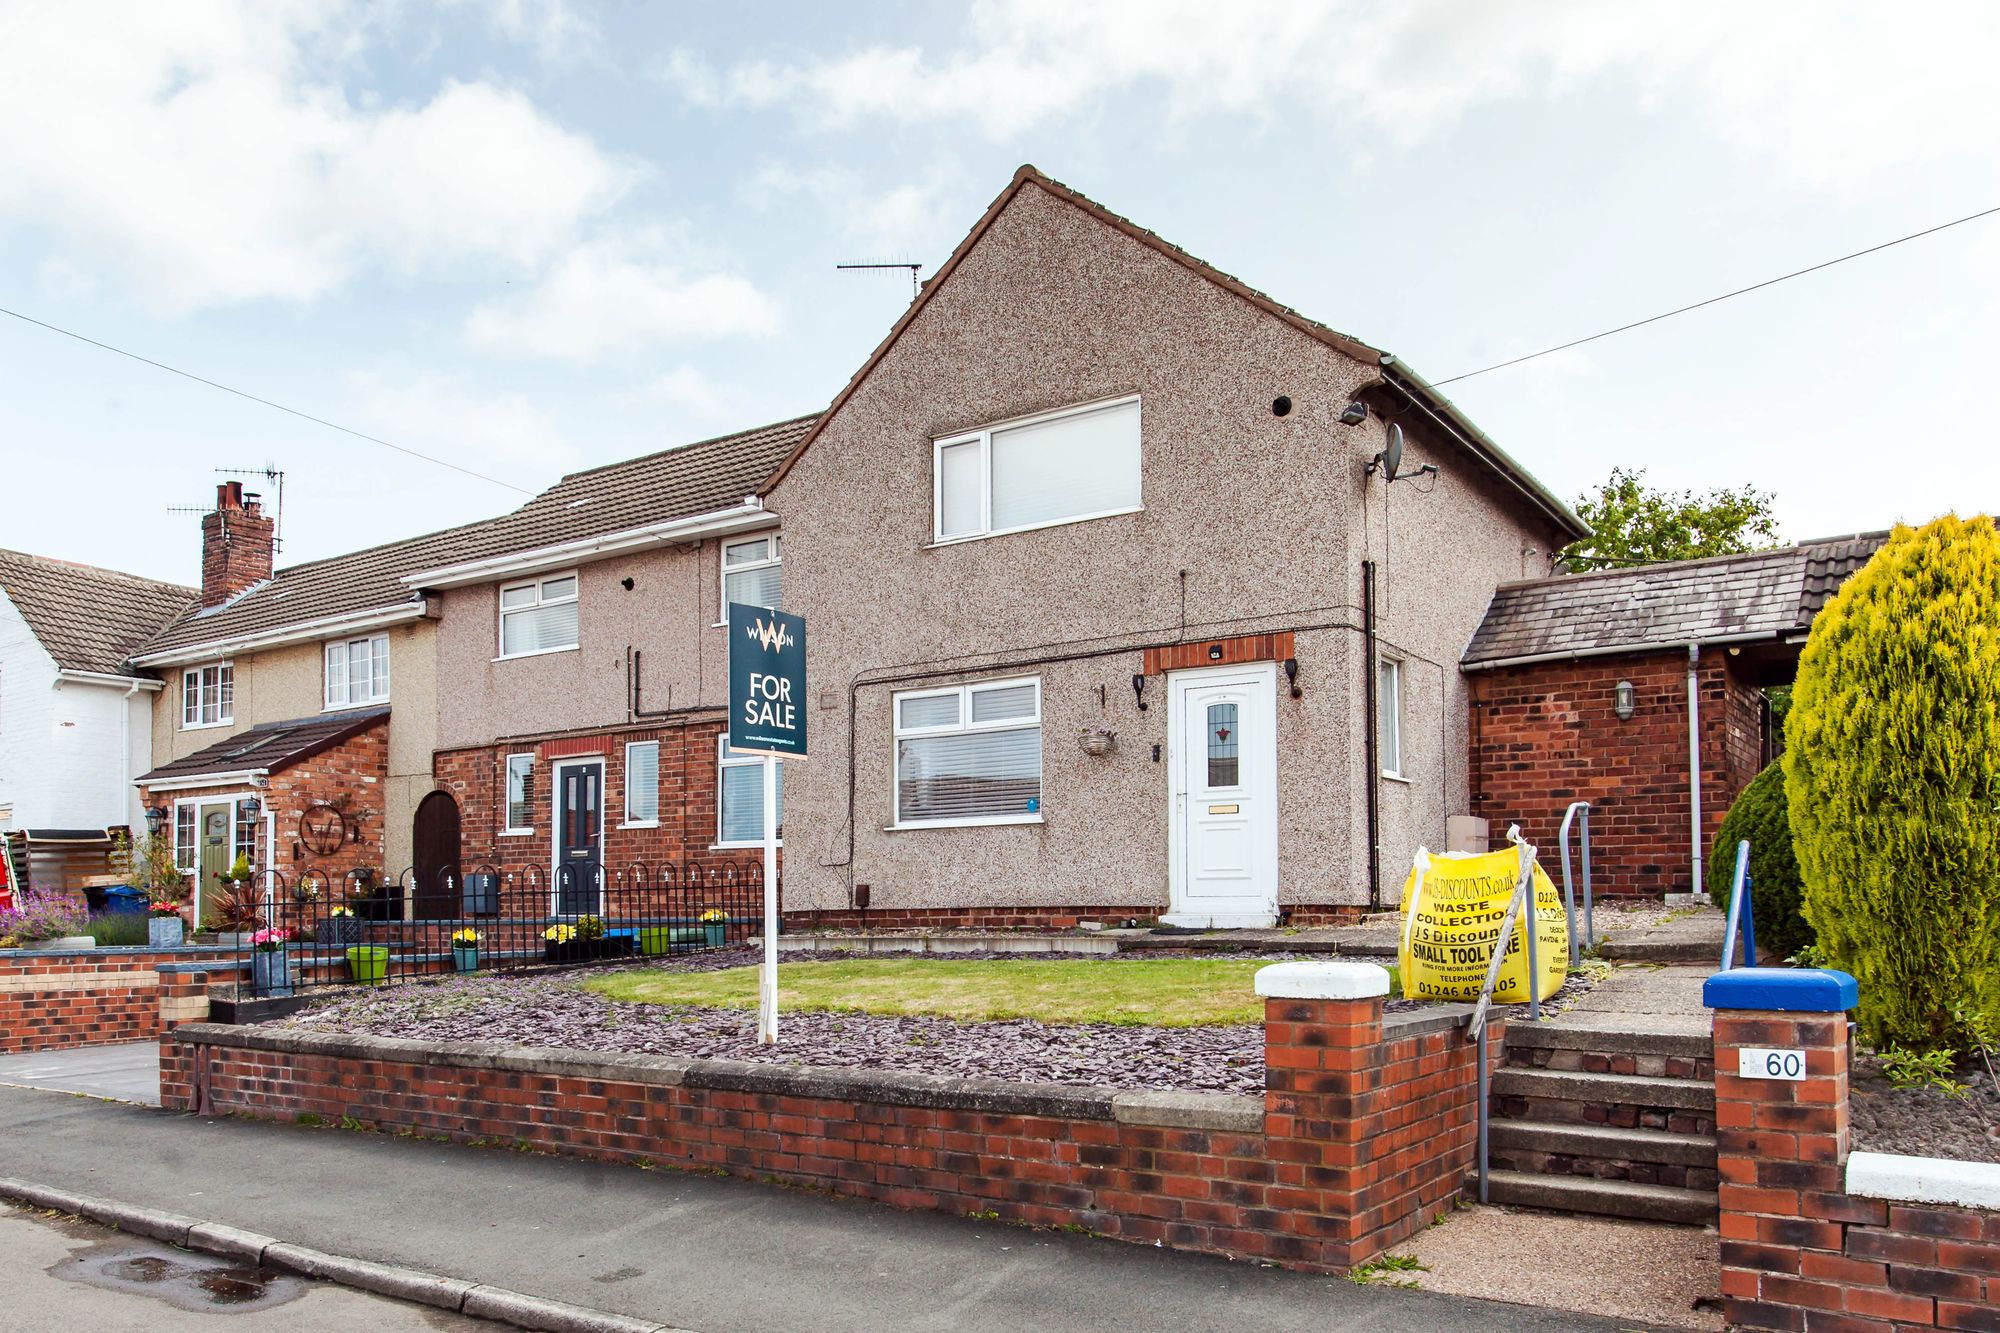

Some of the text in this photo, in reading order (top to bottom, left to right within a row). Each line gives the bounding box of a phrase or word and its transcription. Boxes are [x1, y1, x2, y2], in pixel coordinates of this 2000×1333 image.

[750, 672, 791, 703] FOR
[745, 699, 796, 730] SALE
[1433, 900, 1490, 913] WASTE
[1416, 908, 1509, 927] COLLECTIO
[1415, 926, 1420, 938] J
[1422, 928, 1429, 940] S
[1413, 937, 1520, 964] SMALL TOOL HRE
[1446, 964, 1463, 972] MORE
[1419, 982, 1459, 997] 01246
[1766, 1053, 1800, 1077] 60
